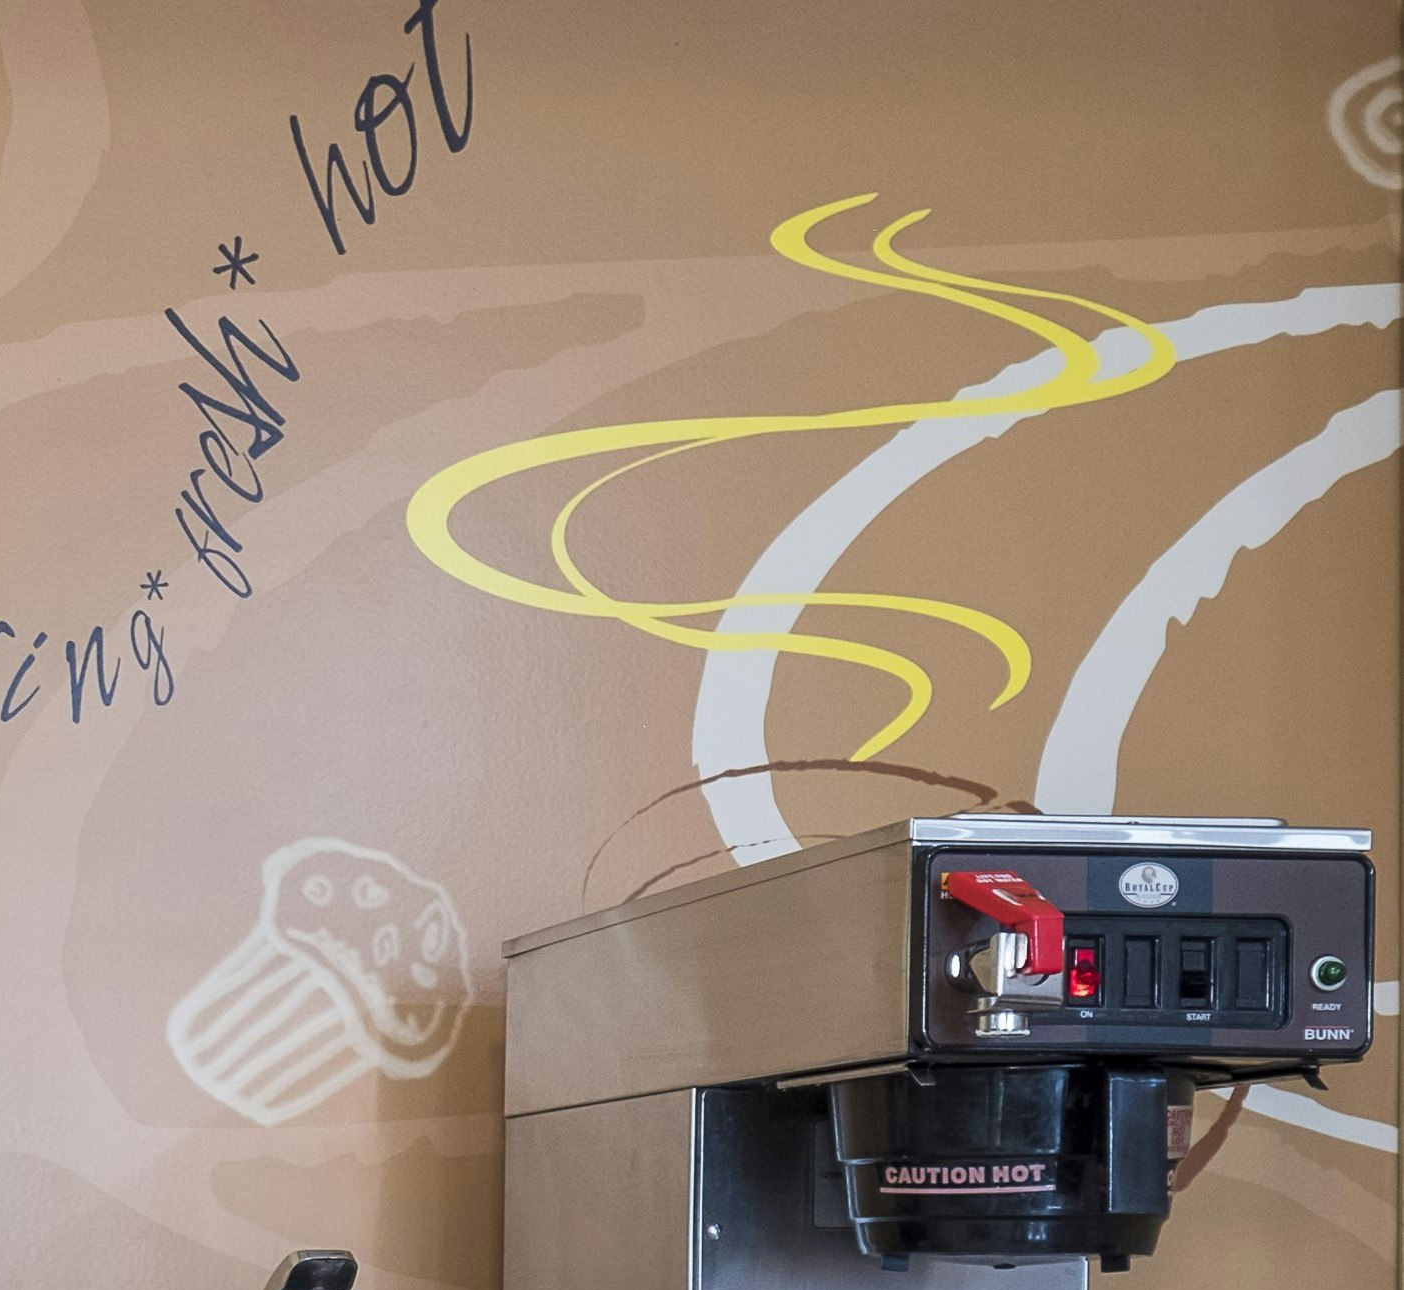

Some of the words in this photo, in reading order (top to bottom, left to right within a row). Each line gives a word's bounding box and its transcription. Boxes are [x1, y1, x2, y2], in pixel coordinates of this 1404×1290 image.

[289, 0, 474, 256] hot
[1313, 1003, 1342, 1012] READY
[1080, 1010, 1093, 1018] ON
[1186, 1013, 1211, 1022] START
[1304, 1028, 1351, 1041] BUNN
[885, 1166, 986, 1184] CAUTION
[992, 1164, 1046, 1183] HOT
